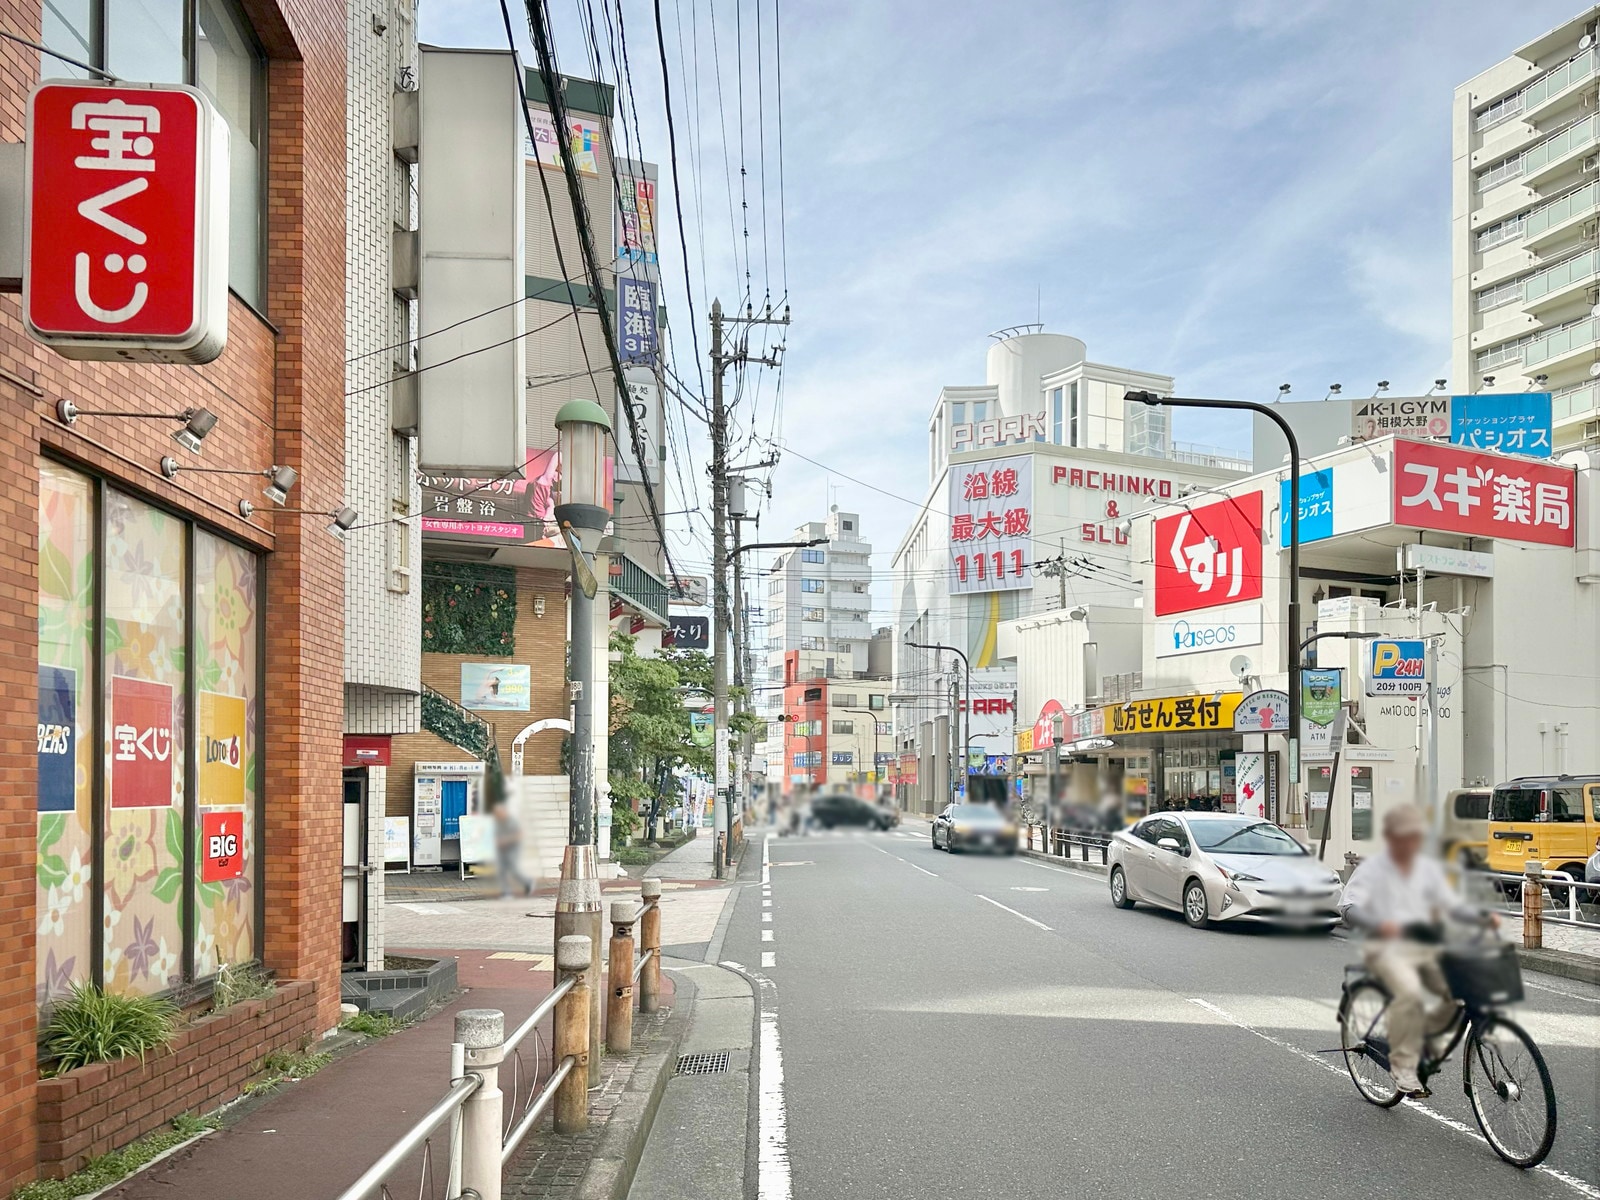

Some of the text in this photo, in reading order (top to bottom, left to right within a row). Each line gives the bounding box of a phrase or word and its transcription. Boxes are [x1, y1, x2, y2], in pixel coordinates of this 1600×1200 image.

[71, 98, 161, 324] 宝くじ
[1376, 415, 1428, 428] 相模大野
[1400, 400, 1447, 415] GYM
[1457, 415, 1536, 426] ファッションプラザ
[951, 410, 1047, 449] PARK
[1458, 428, 1550, 450] パシオス
[963, 468, 1019, 501] 沿線
[1052, 465, 1172, 499] PACHINKO
[1401, 462, 1570, 530] スギ薬局
[434, 496, 496, 517] 岩盤浴
[1105, 499, 1120, 519] &
[425, 520, 519, 535] 女性専用ホットヨガスタジオ
[951, 508, 1031, 541] 最大級
[955, 549, 1025, 582] 1111
[1170, 514, 1243, 598] くすり
[1173, 619, 1235, 649] Paseos
[1395, 658, 1424, 676] 24H
[1376, 682, 1422, 691] 20分 100円
[1113, 697, 1222, 732] 処方せん受付
[115, 723, 171, 762] 宝くじ
[208, 833, 238, 859] BIG
